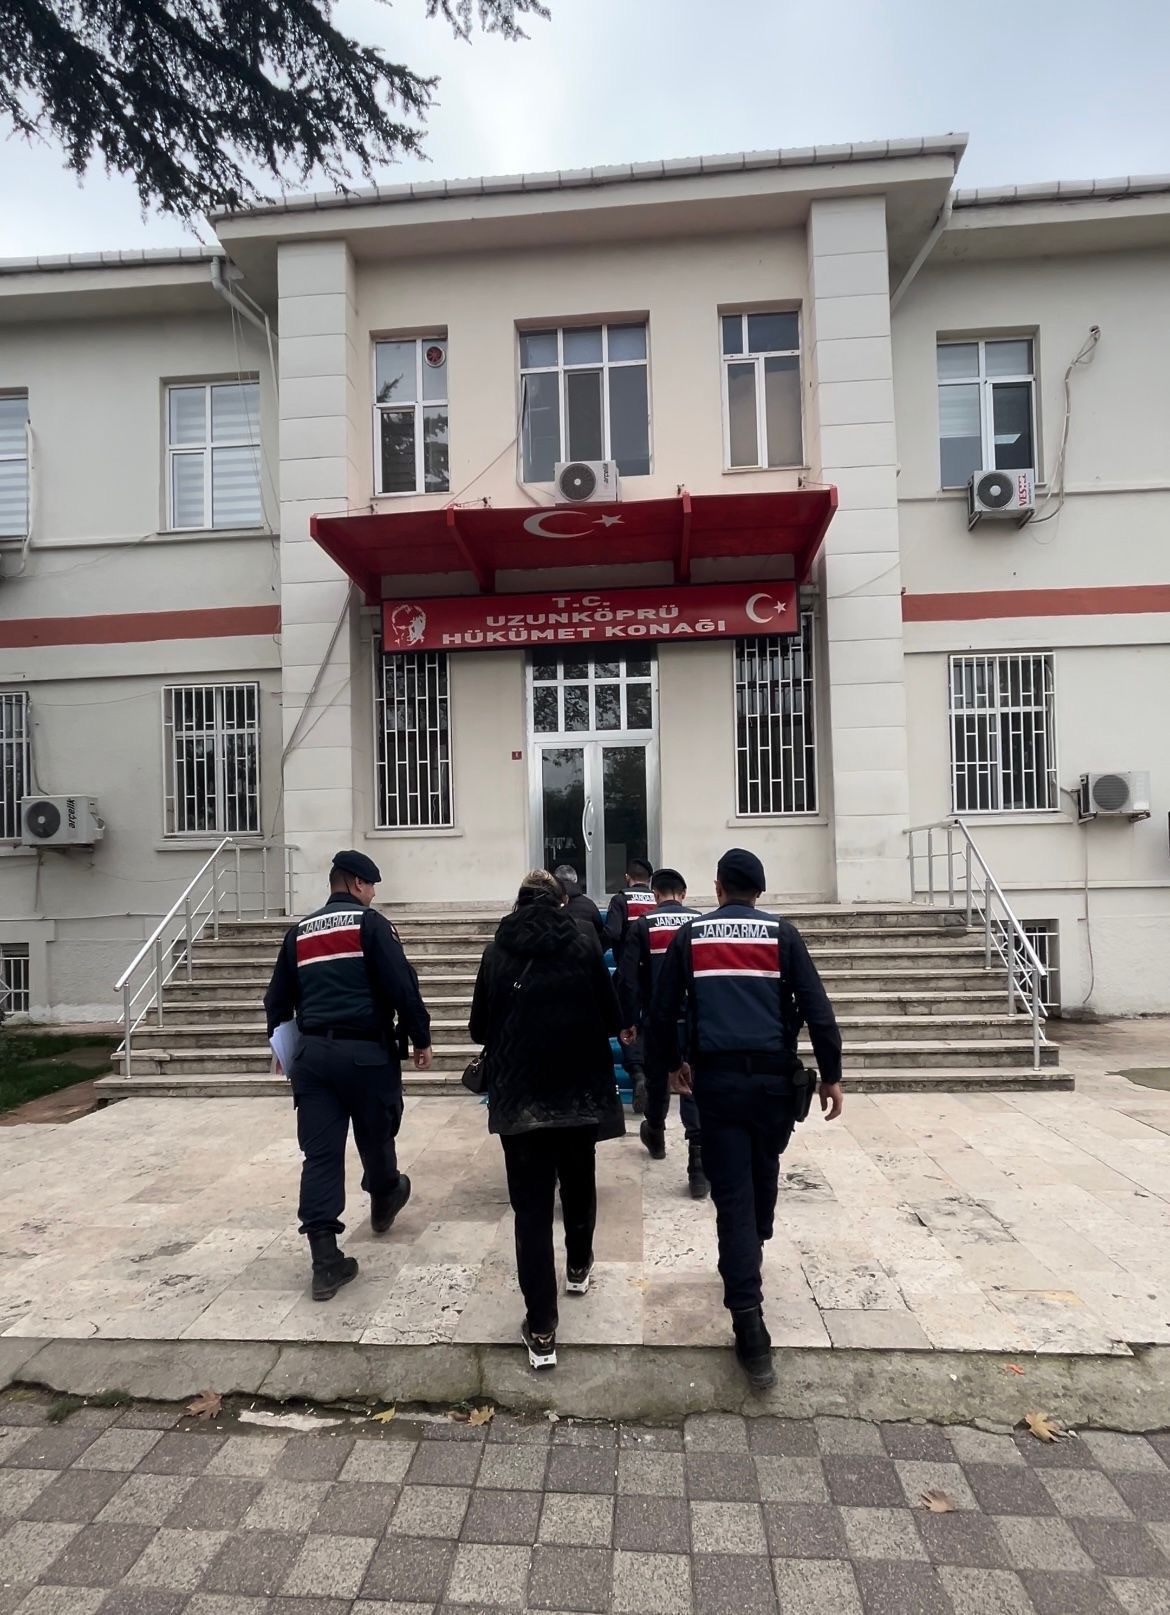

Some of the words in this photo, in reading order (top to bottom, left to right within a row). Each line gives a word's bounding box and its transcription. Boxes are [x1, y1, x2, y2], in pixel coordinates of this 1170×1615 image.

[551, 596, 611, 608] T.C.
[486, 604, 679, 627] UZUNKÖPRÜ
[442, 627, 596, 645] HÜKÜMET
[605, 618, 726, 637] KONAĞI
[67, 799, 77, 828] arçelik
[303, 914, 355, 934] JANDARMA
[699, 924, 769, 938] JANDARMA
